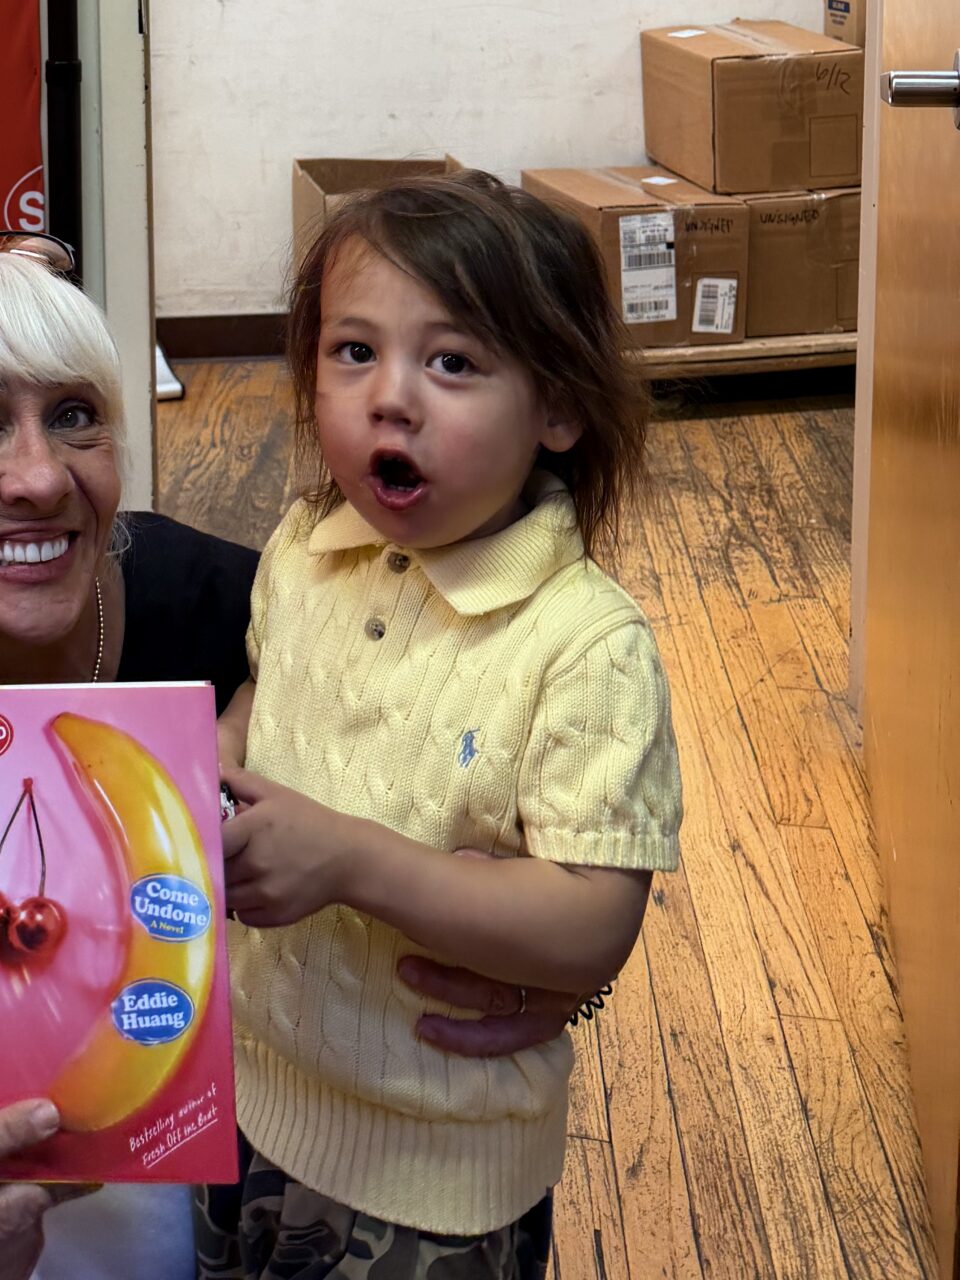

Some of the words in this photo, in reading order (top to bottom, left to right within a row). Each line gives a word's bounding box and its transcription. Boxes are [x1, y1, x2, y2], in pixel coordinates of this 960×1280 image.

[146, 882, 199, 906] Come
[134, 896, 207, 926] Undone
[150, 920, 158, 929] A
[159, 922, 184, 935] Novel
[122, 992, 178, 1012] Eddie
[121, 1011, 185, 1030] Huang
[130, 1113, 174, 1152] Bestselling
